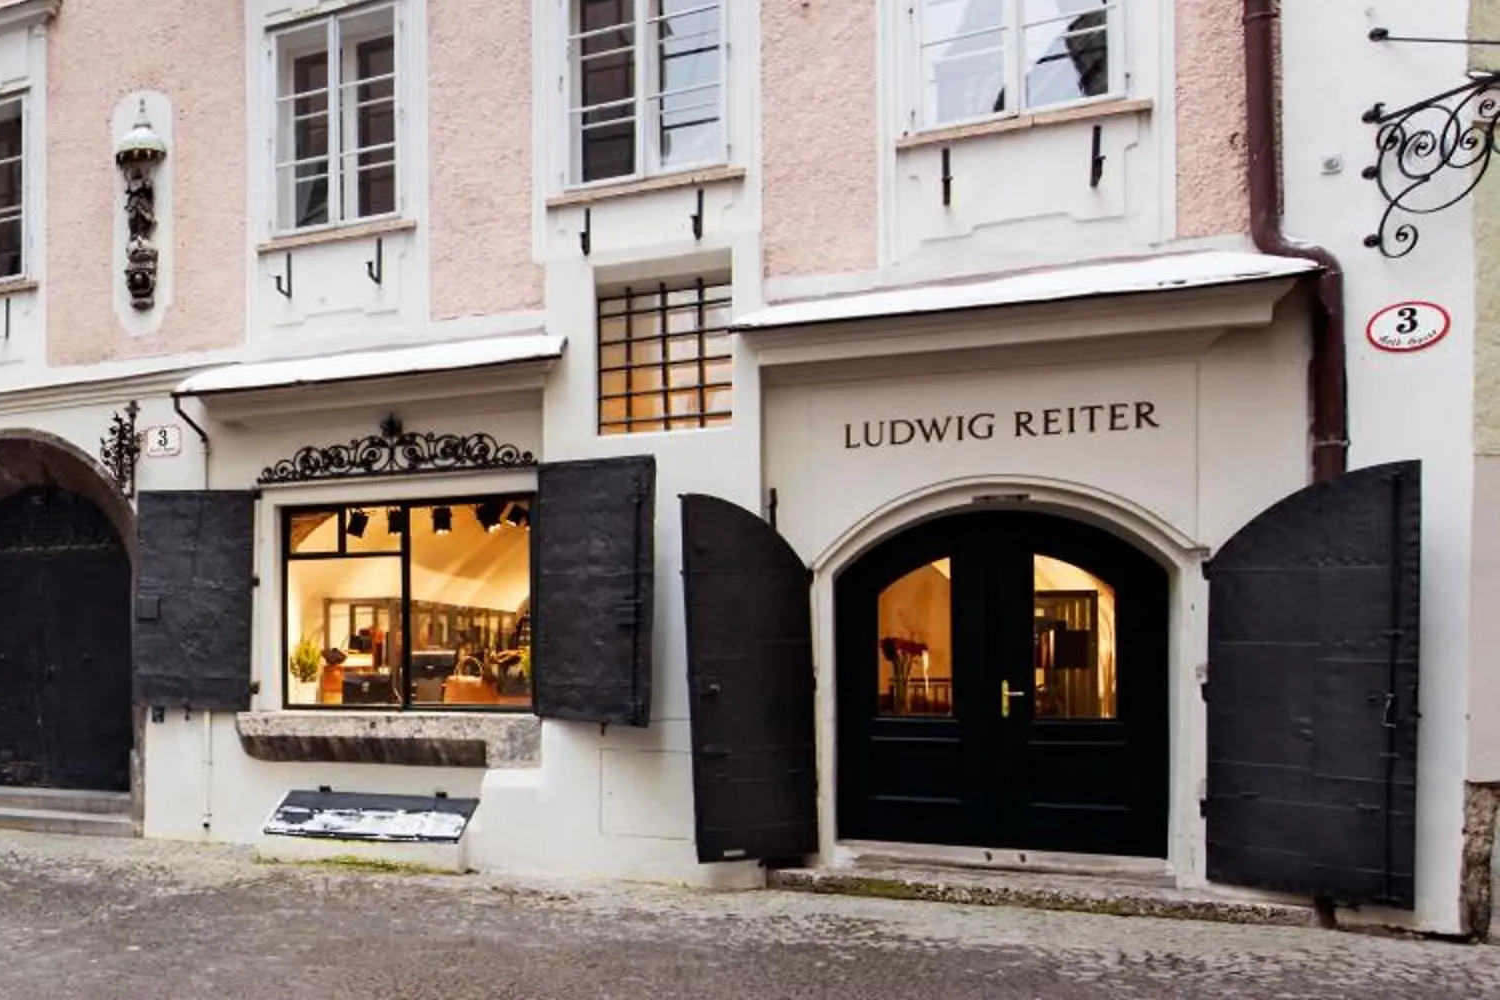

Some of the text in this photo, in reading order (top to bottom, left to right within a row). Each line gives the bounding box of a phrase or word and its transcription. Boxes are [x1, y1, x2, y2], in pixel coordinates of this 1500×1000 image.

[1395, 307, 1419, 334] 3
[158, 428, 168, 447] 3
[844, 401, 1160, 449] LUDWIG REITER
